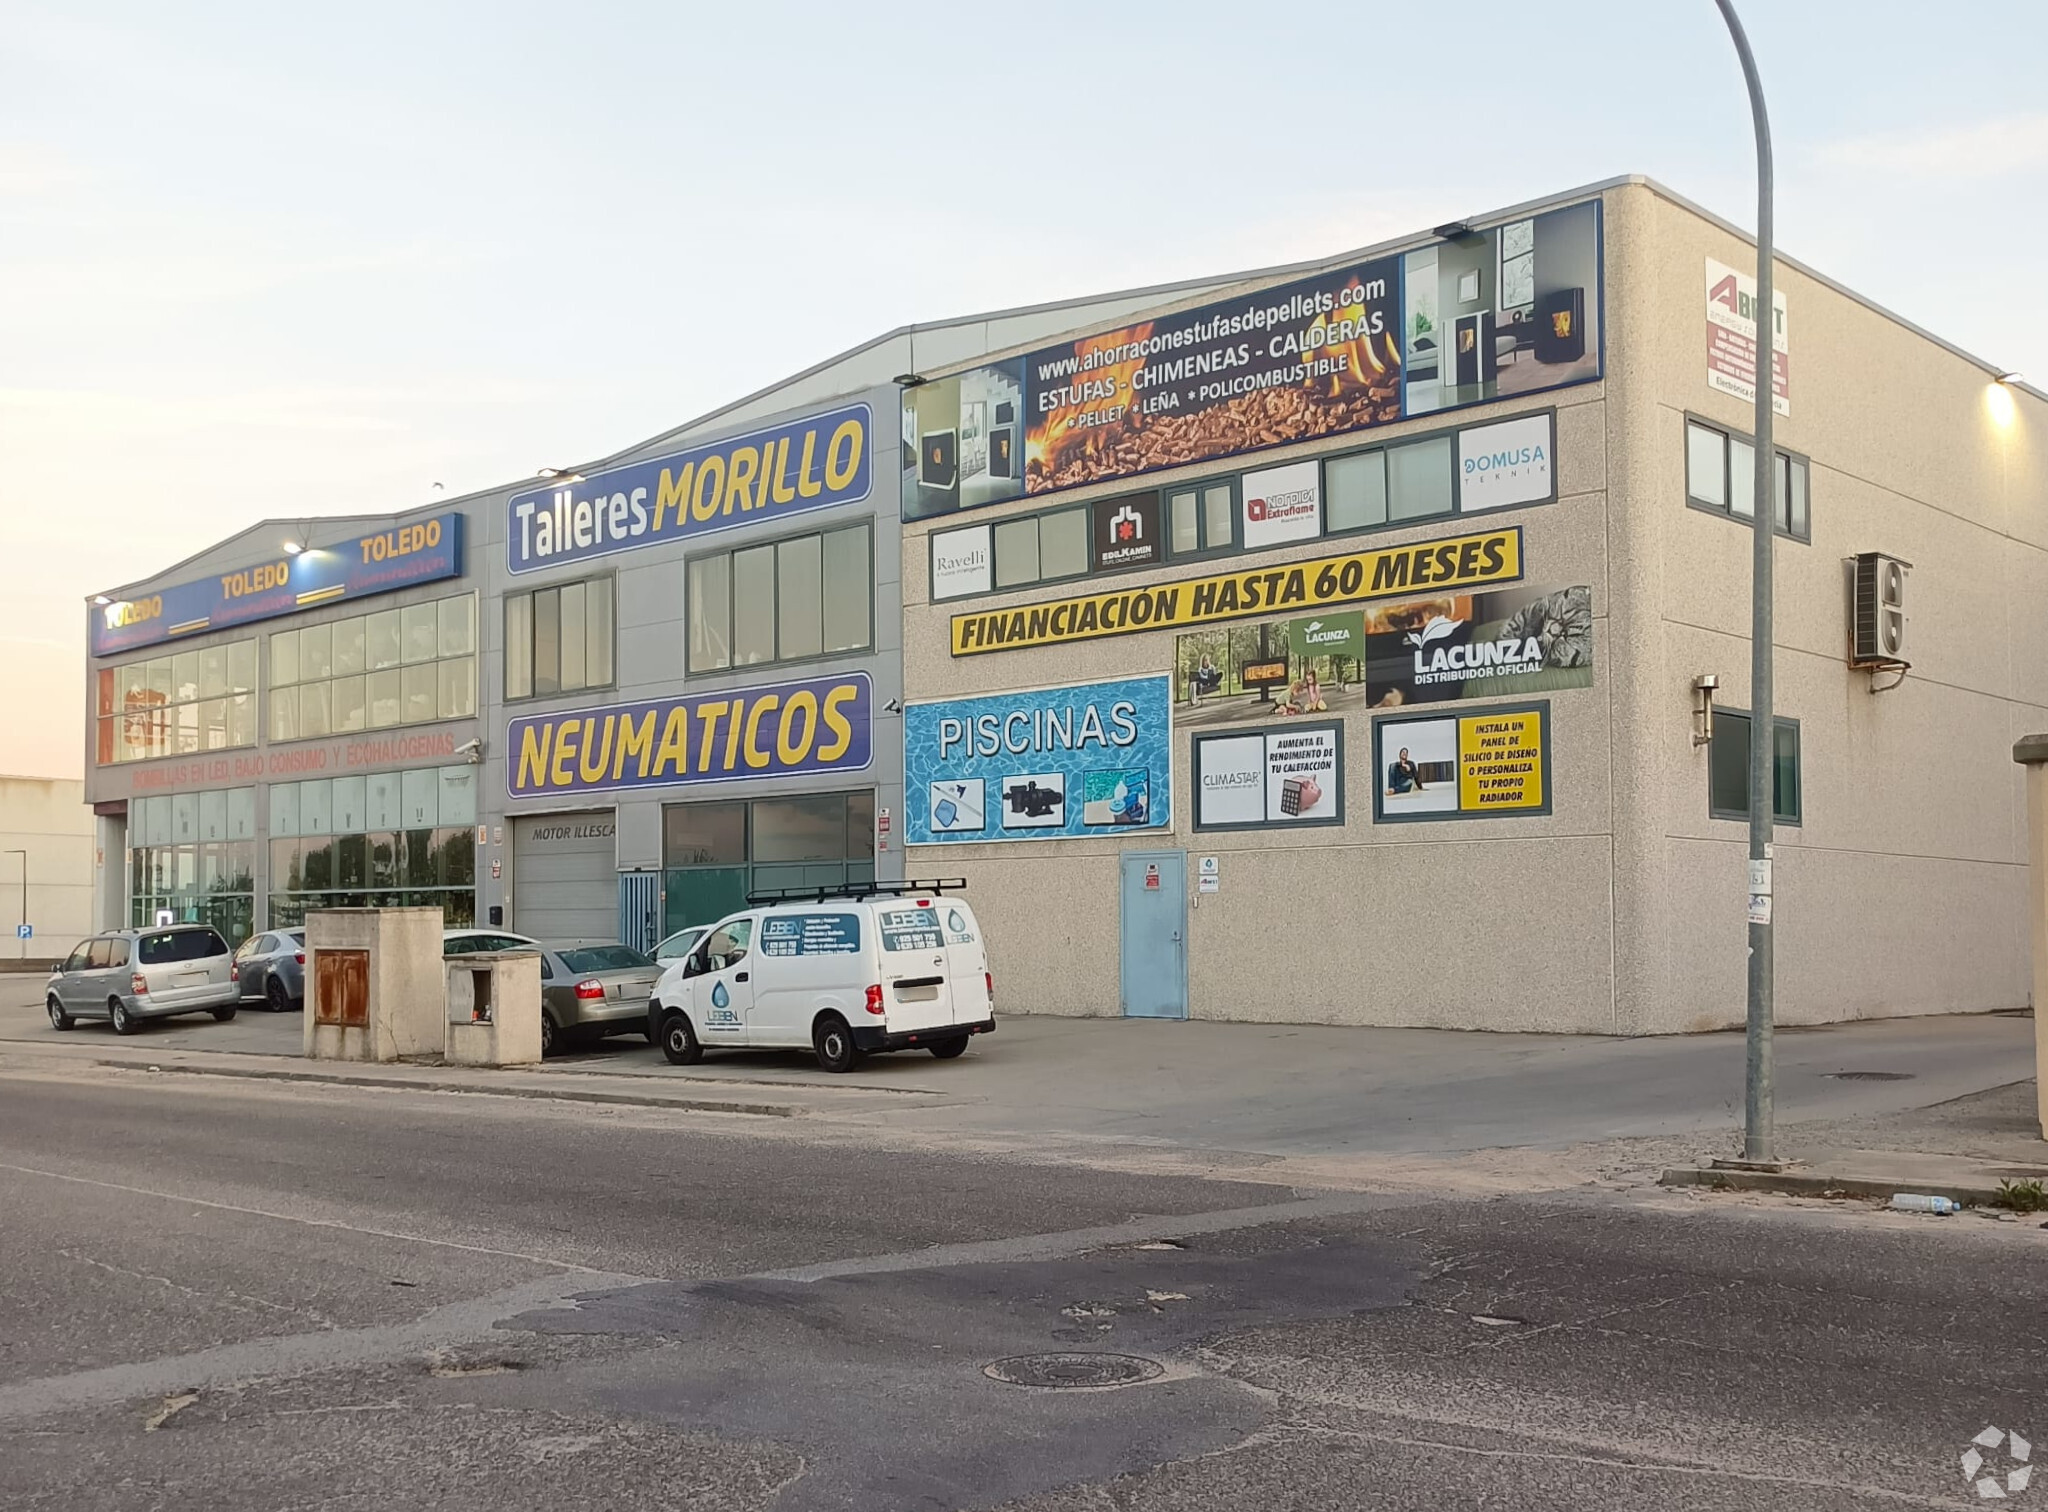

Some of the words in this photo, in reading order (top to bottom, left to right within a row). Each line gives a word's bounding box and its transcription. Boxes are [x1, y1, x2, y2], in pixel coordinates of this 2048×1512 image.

[1038, 278, 1386, 381] www.ahorraconestufasdepellets.com
[1039, 376, 1115, 412] ESTUFAS
[1132, 343, 1249, 391] CHIMENEAS
[1269, 311, 1384, 358] CALDERAS
[1078, 404, 1125, 429] PELLET
[1143, 390, 1180, 414] LEÑA
[1200, 353, 1348, 401] POLICOMBUSTIBLE
[1464, 445, 1545, 474] DOMUSA
[516, 487, 647, 561] Talleres
[652, 420, 863, 531] MORILLO
[1267, 504, 1314, 519] Extraflame
[360, 519, 441, 564] TOLEDO
[938, 550, 984, 570] Ravelli
[221, 561, 289, 599] TOLEDO
[960, 587, 1179, 649] FINANCIACIÓN
[1191, 568, 1306, 617] HASTA
[1314, 559, 1363, 598] 60
[1370, 537, 1506, 591] MESES
[1306, 629, 1350, 643] LACUNZA
[1414, 636, 1543, 674] LACUNZA
[1414, 667, 1494, 685] DISTRIBUIDOR
[1496, 661, 1543, 676] OFICIAL
[516, 685, 858, 788] NEUMATICOS
[939, 701, 1137, 759] PISCINAS
[1475, 723, 1510, 734] INSTALA
[1512, 721, 1524, 731] UN
[1277, 737, 1314, 749] AUMENTA
[1316, 736, 1324, 746] EL
[1481, 736, 1506, 748] PANEL
[1509, 736, 1520, 745] DE
[1269, 749, 1321, 762] RENDIMIENTO
[1323, 748, 1334, 757] DE
[1463, 751, 1492, 763] SILICIO
[1494, 751, 1505, 760] DE
[1507, 746, 1538, 759] DISEÑO
[191, 761, 205, 783] EN
[235, 755, 264, 777] BAJO
[269, 747, 327, 773] CONSUMO
[333, 745, 341, 767] Y
[1271, 764, 1281, 774] TU
[1283, 758, 1332, 773] CALEFACCIÓN
[1477, 763, 1533, 775] PERSONALIZA
[1203, 771, 1259, 786] CLIMASTAR
[1479, 779, 1489, 789] TU
[1491, 777, 1524, 788] PROPIO
[1479, 791, 1523, 803] RADIADOR
[532, 827, 571, 841] MOTOR
[20, 925, 31, 938] P
